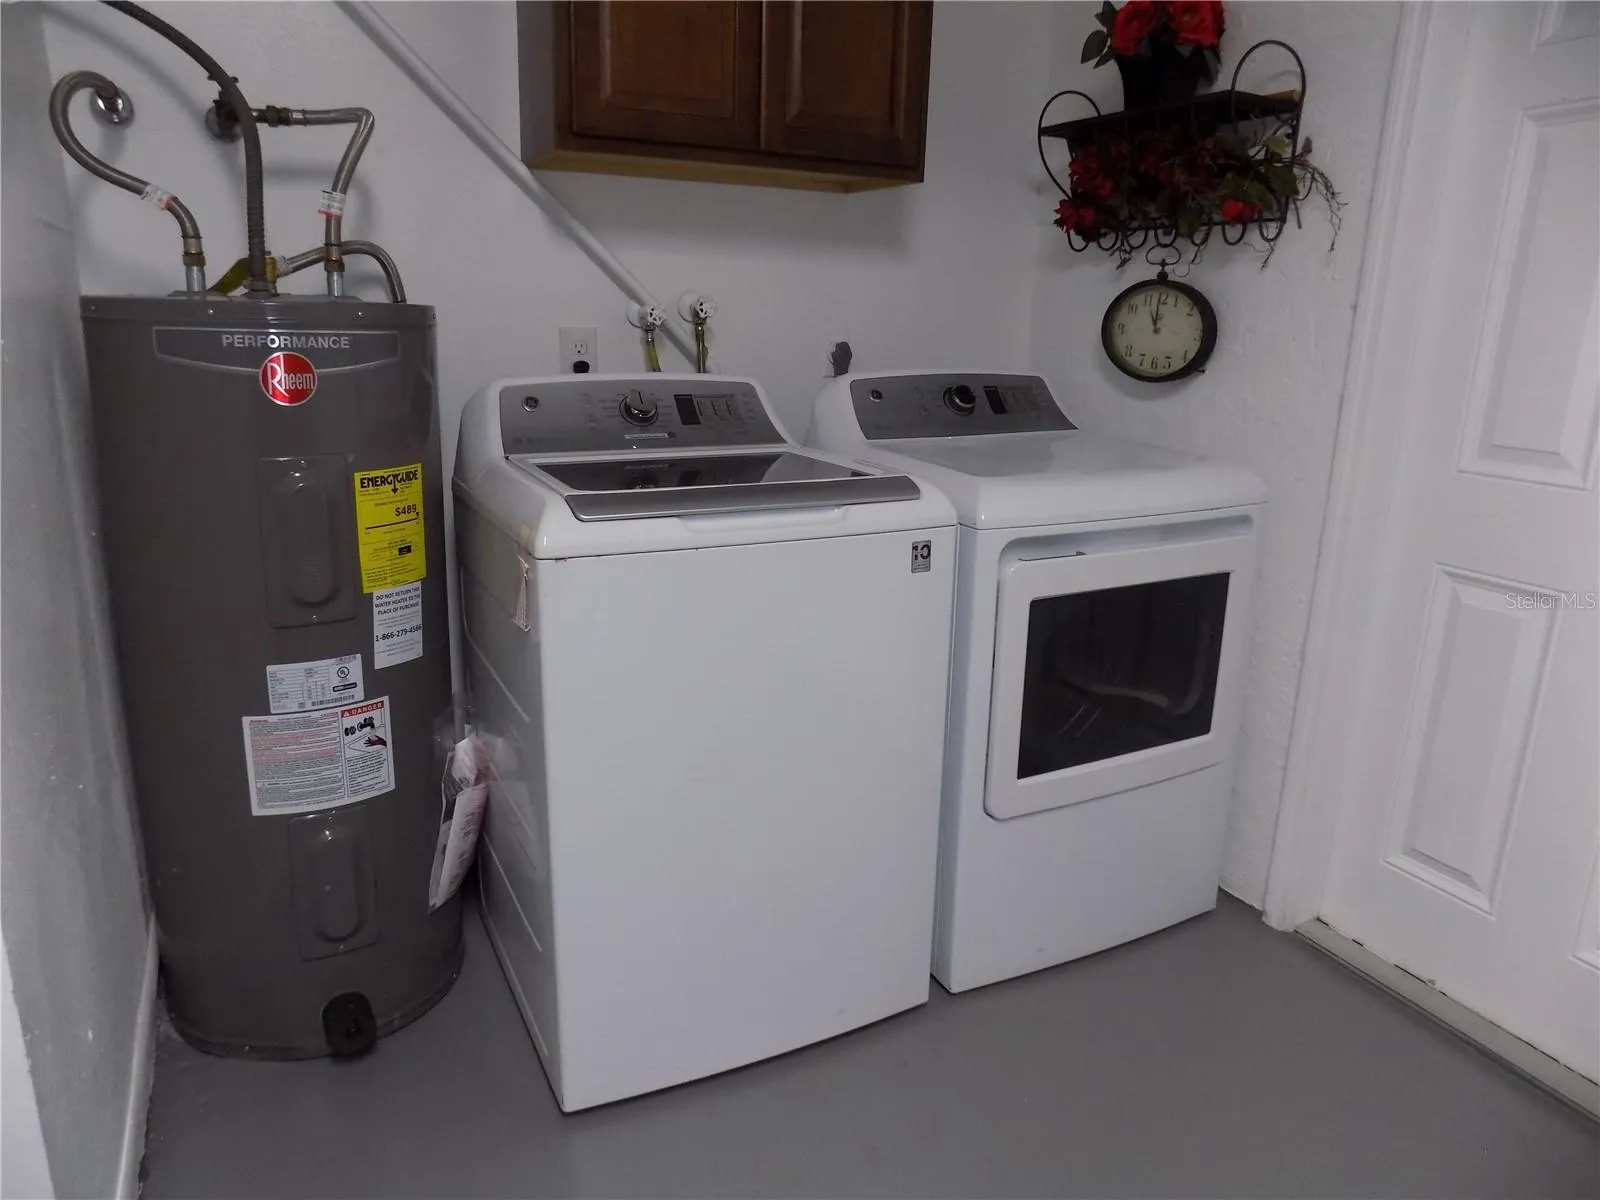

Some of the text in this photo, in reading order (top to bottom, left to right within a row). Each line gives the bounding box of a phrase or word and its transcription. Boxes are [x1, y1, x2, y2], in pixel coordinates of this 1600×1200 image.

[1127, 302, 1138, 315] 10
[1186, 302, 1194, 317] 2
[1118, 322, 1125, 335] 9
[222, 334, 350, 350] PERFORMANCE
[1125, 344, 1133, 358] 8
[1139, 353, 1147, 368] 7
[1151, 356, 1159, 371] 6
[1163, 356, 1173, 371] 5
[267, 354, 314, 397] Rheem
[360, 469, 419, 490] ENERGYGUIDE
[385, 591, 395, 599] NOT
[351, 703, 382, 714] DANGER
